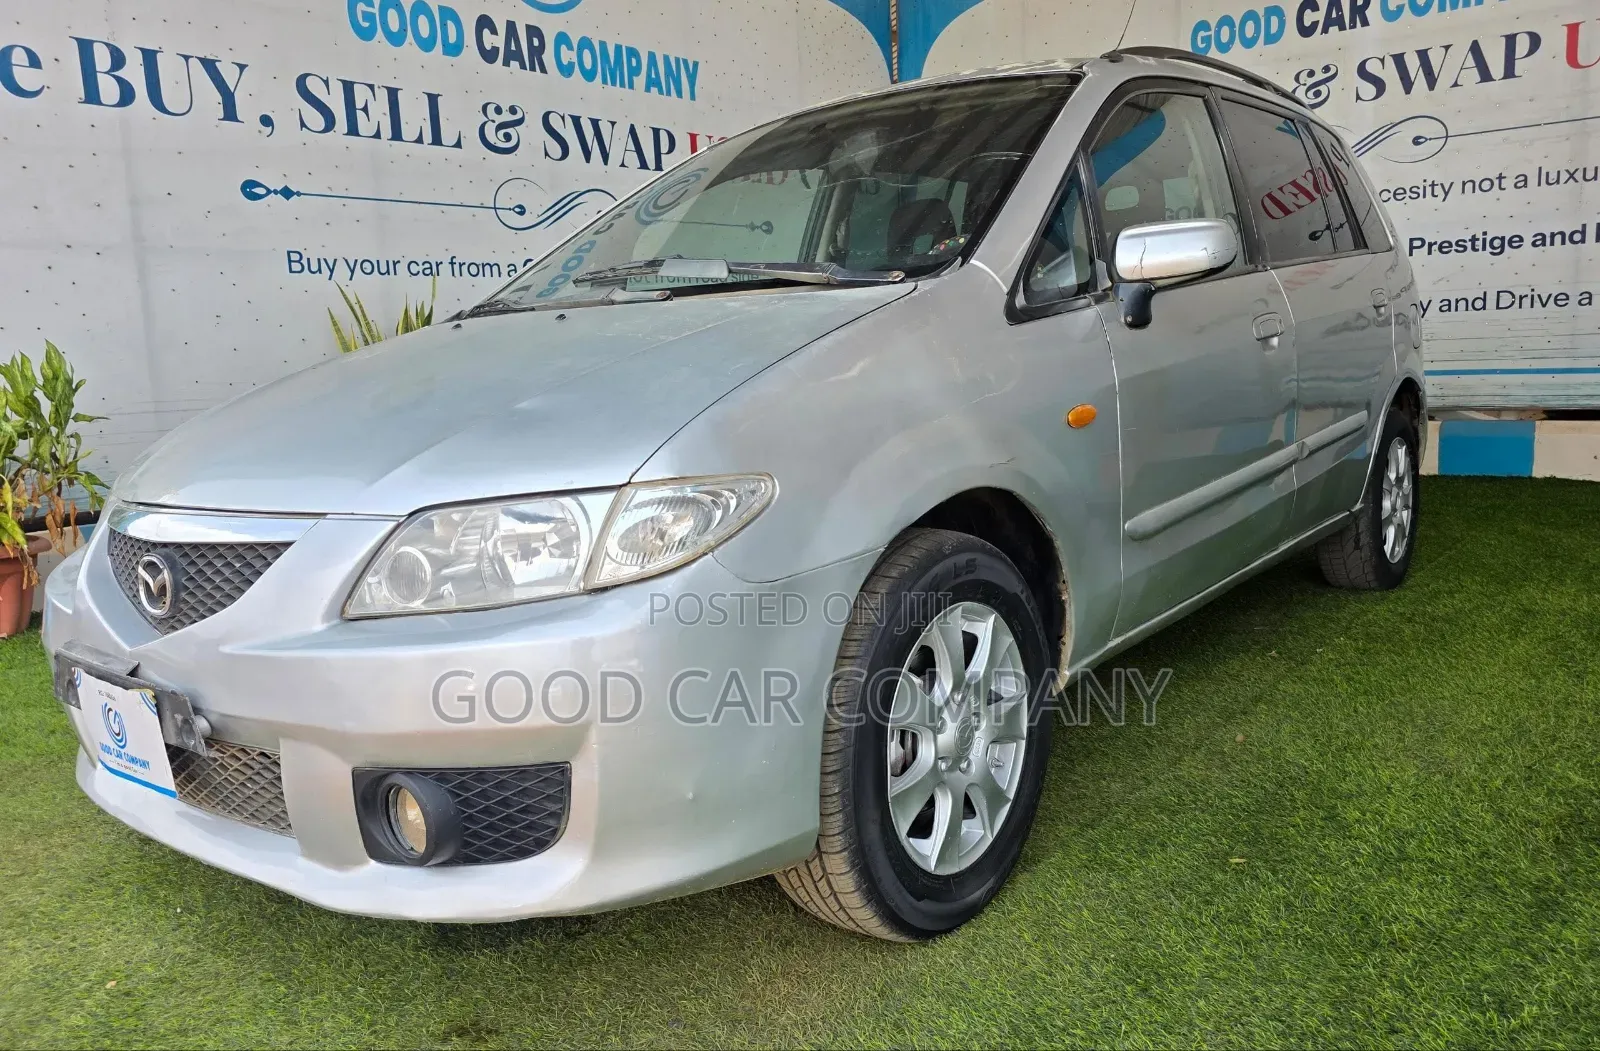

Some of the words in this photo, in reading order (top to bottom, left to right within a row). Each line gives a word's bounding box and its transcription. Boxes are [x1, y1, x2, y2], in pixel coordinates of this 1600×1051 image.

[1190, 5, 1286, 56] GOOD
[1296, 0, 1370, 38] CAR
[347, 0, 464, 58] GOOD
[475, 14, 548, 74] CAR
[553, 31, 699, 101] COMPANY
[1292, 64, 1338, 109] &
[1356, 31, 1542, 103] SWAP
[69, 36, 275, 137] BUY,
[295, 72, 463, 150] SELL
[478, 101, 525, 155] &
[541, 110, 677, 172] SWAP
[1461, 172, 1506, 195] not
[1513, 173, 1528, 189] a
[1537, 166, 1599, 188] luxu
[1408, 231, 1524, 256] Prestige
[1531, 223, 1587, 247] and
[286, 250, 338, 281] Buy
[343, 257, 401, 281] your
[407, 258, 444, 278] car
[448, 256, 501, 278] from
[507, 263, 517, 277] a
[1438, 291, 1487, 313] and
[1495, 288, 1570, 311] Drive
[1577, 290, 1593, 306] a
